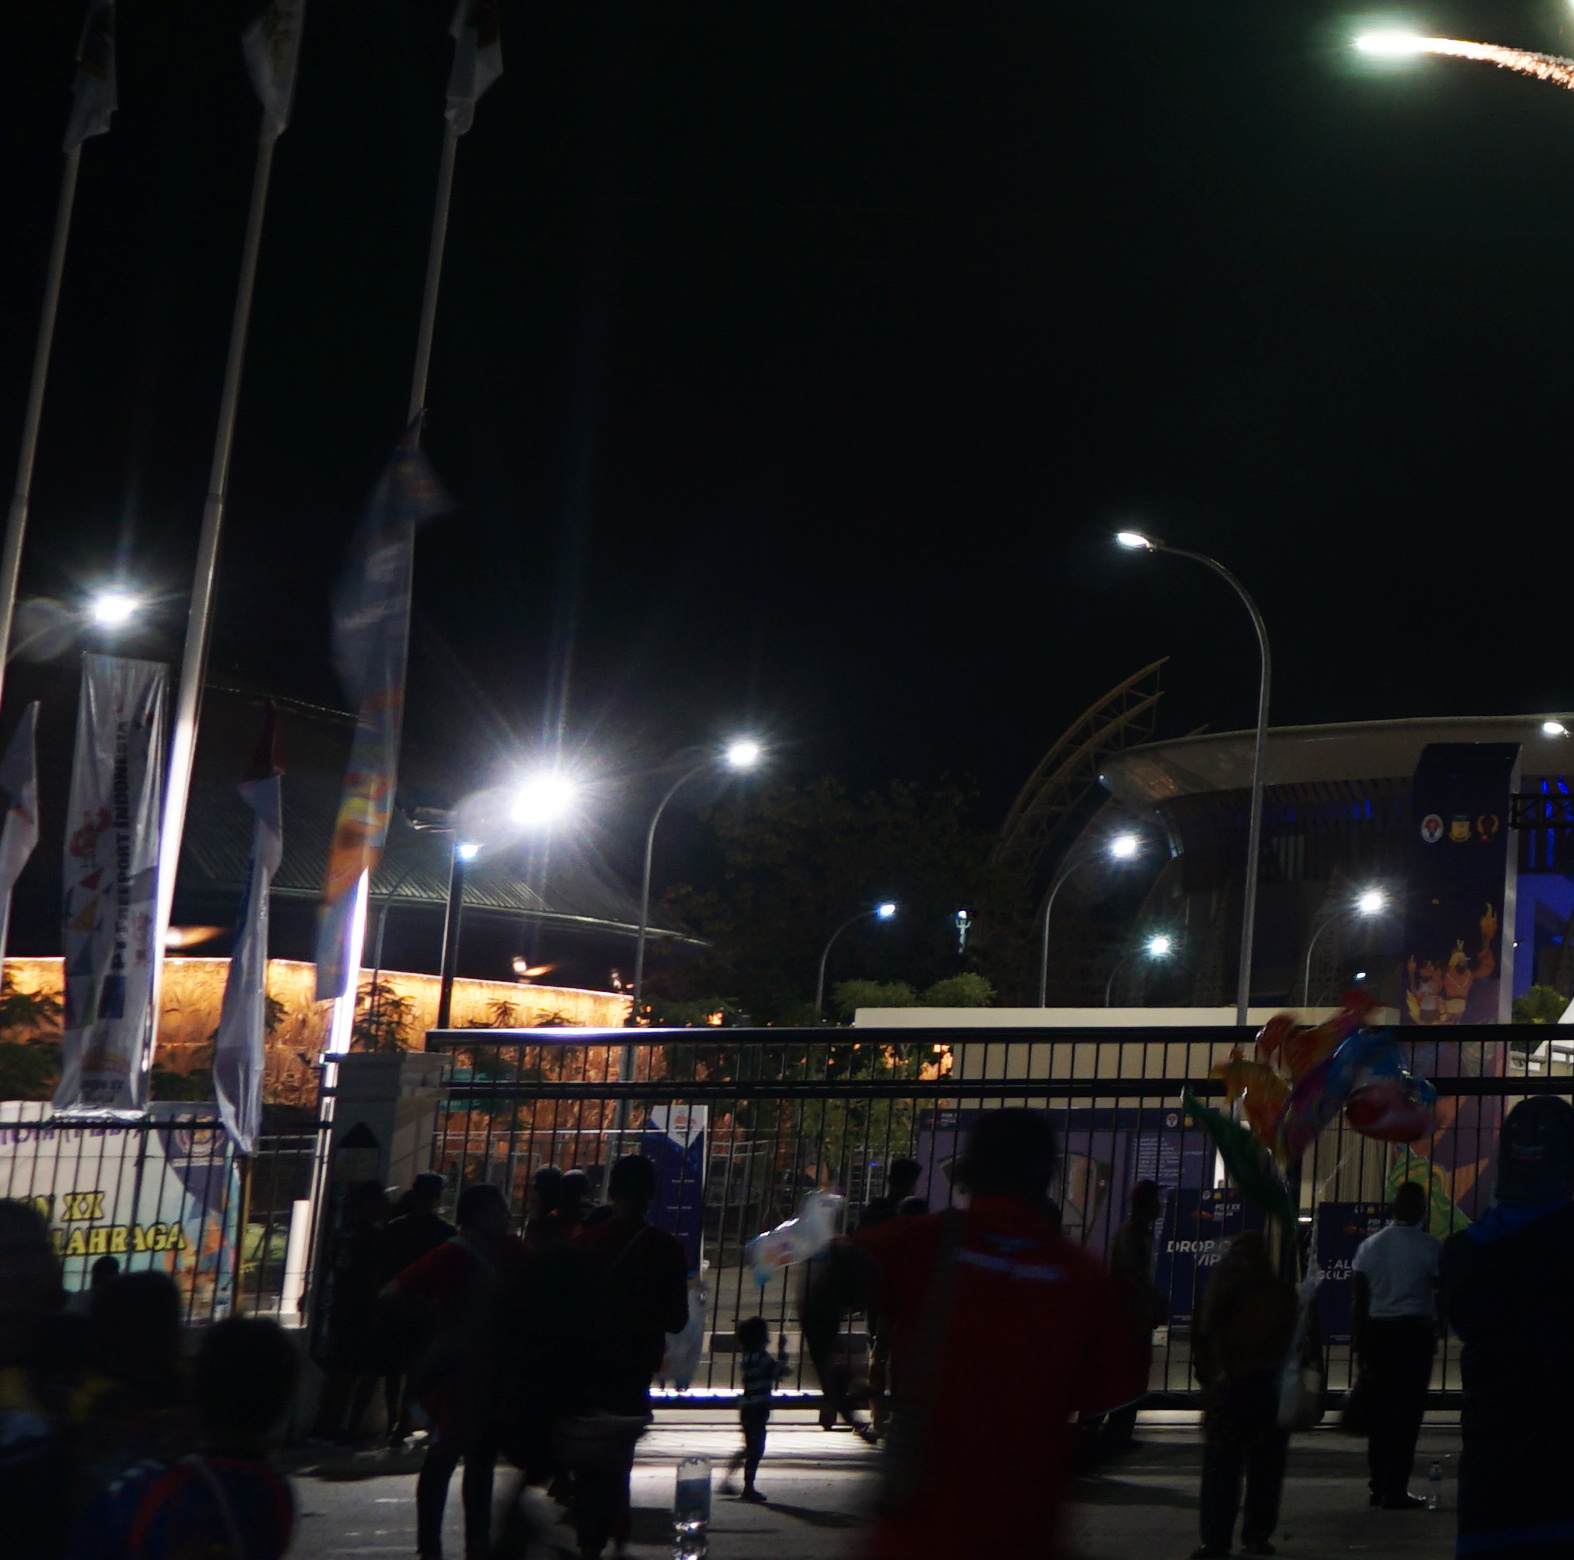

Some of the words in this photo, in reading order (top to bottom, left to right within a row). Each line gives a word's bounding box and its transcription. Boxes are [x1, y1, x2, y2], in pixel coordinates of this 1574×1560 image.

[62, 1191, 104, 1222] XX
[51, 1222, 187, 1257] LAHRAGA
[1166, 1240, 1215, 1253] DROP
